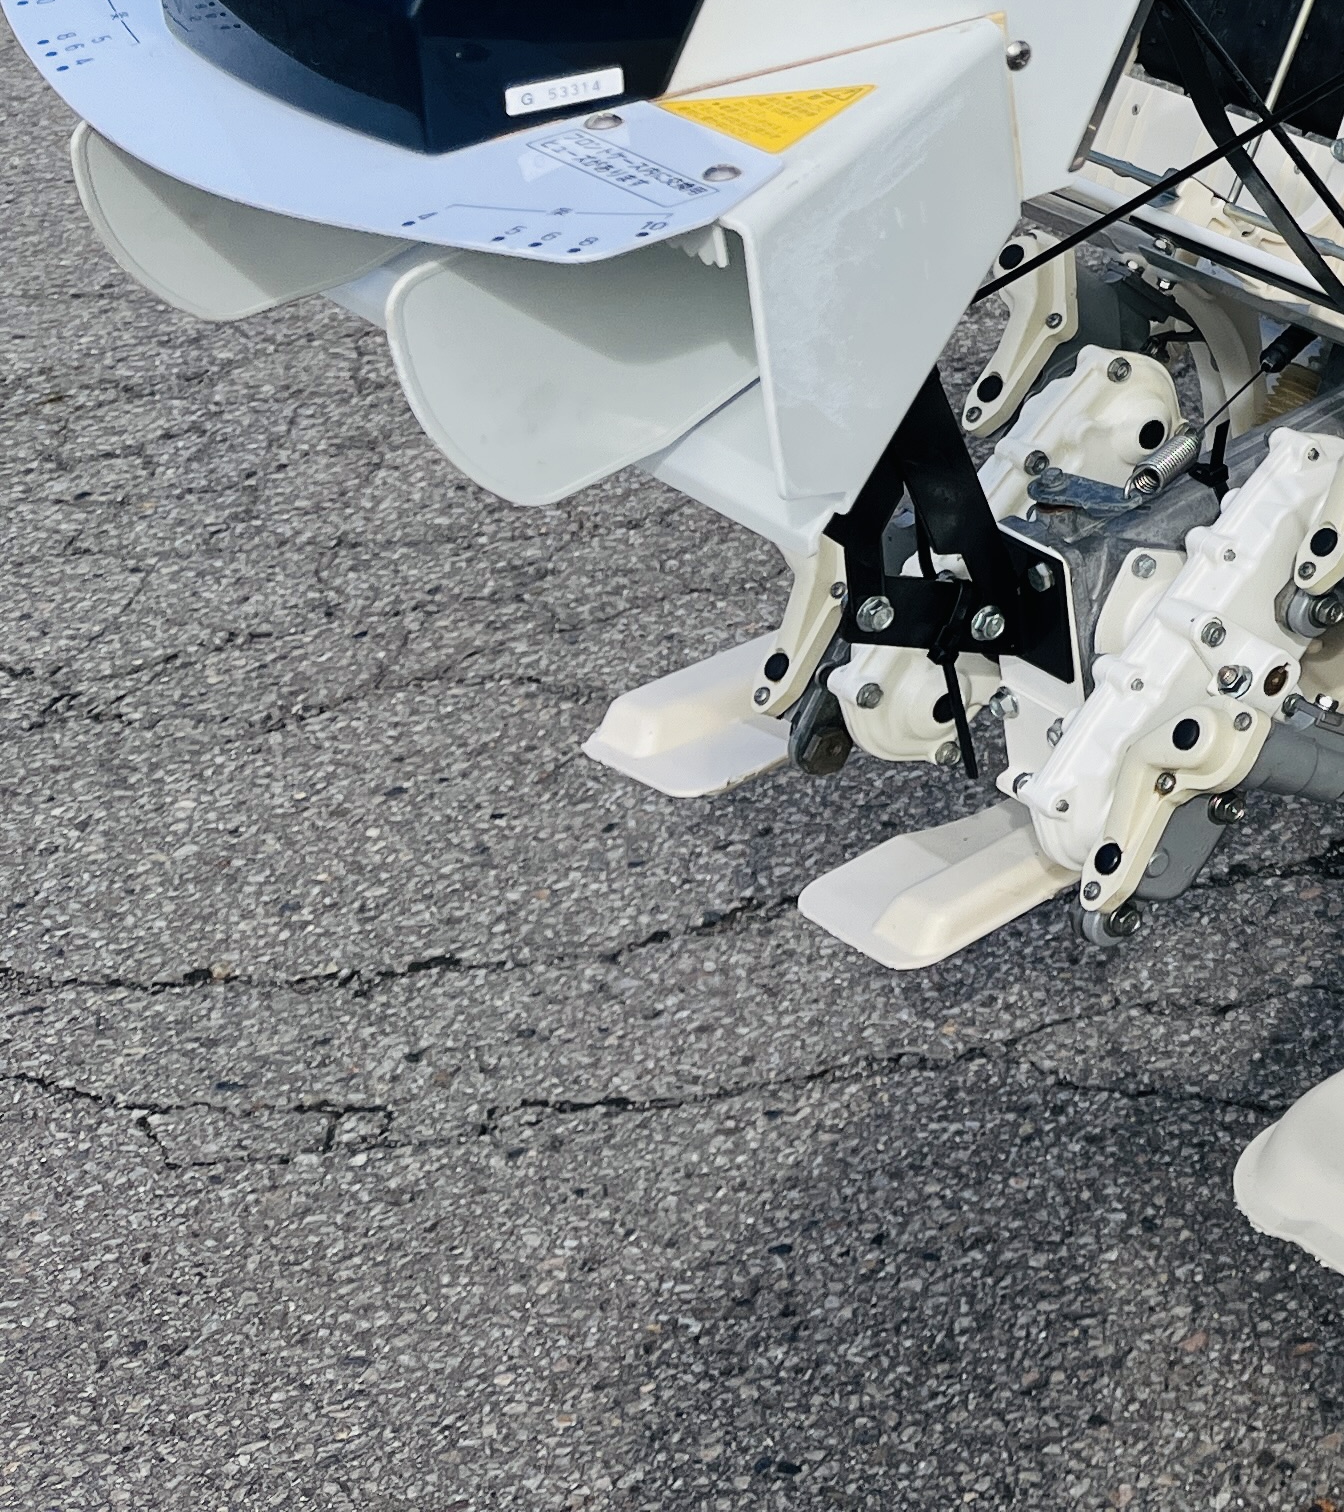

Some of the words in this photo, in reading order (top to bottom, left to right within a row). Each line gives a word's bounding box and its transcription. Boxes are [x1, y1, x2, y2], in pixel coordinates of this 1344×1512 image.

[520, 92, 534, 106] G
[548, 80, 602, 101] 53314
[505, 225, 527, 236] 5
[641, 220, 669, 231] 10
